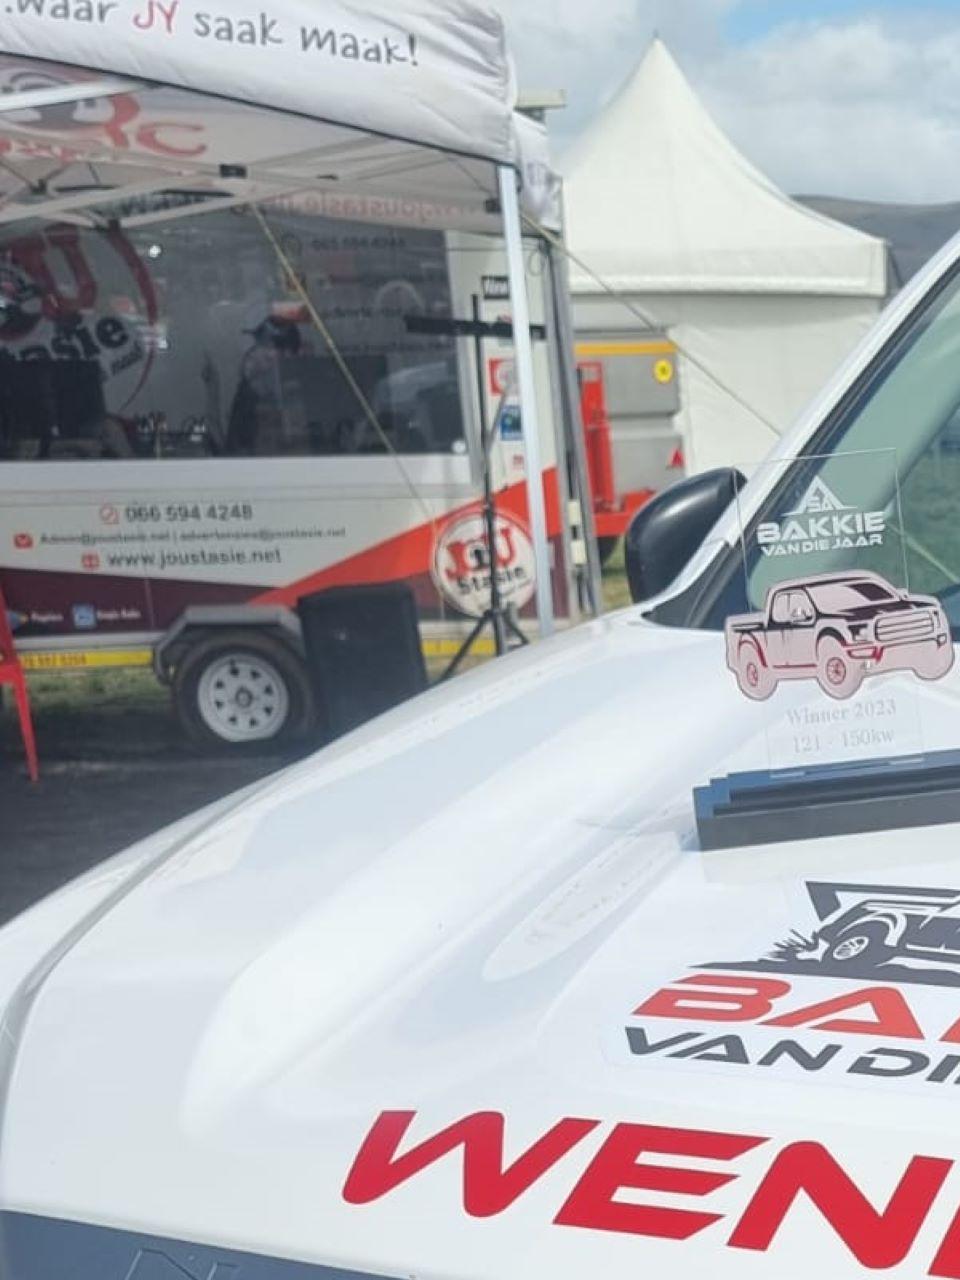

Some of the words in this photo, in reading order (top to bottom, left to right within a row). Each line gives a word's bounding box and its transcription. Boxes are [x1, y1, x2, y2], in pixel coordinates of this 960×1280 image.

[194, 12, 283, 46] saak
[300, 26, 419, 66] maak!
[166, 504, 201, 521] 594
[757, 511, 886, 544] BAKKIE
[107, 548, 282, 569] www.joustasie.net
[785, 706, 850, 725] Winner
[853, 698, 897, 718] 2023
[623, 1025, 844, 1072] VAN
